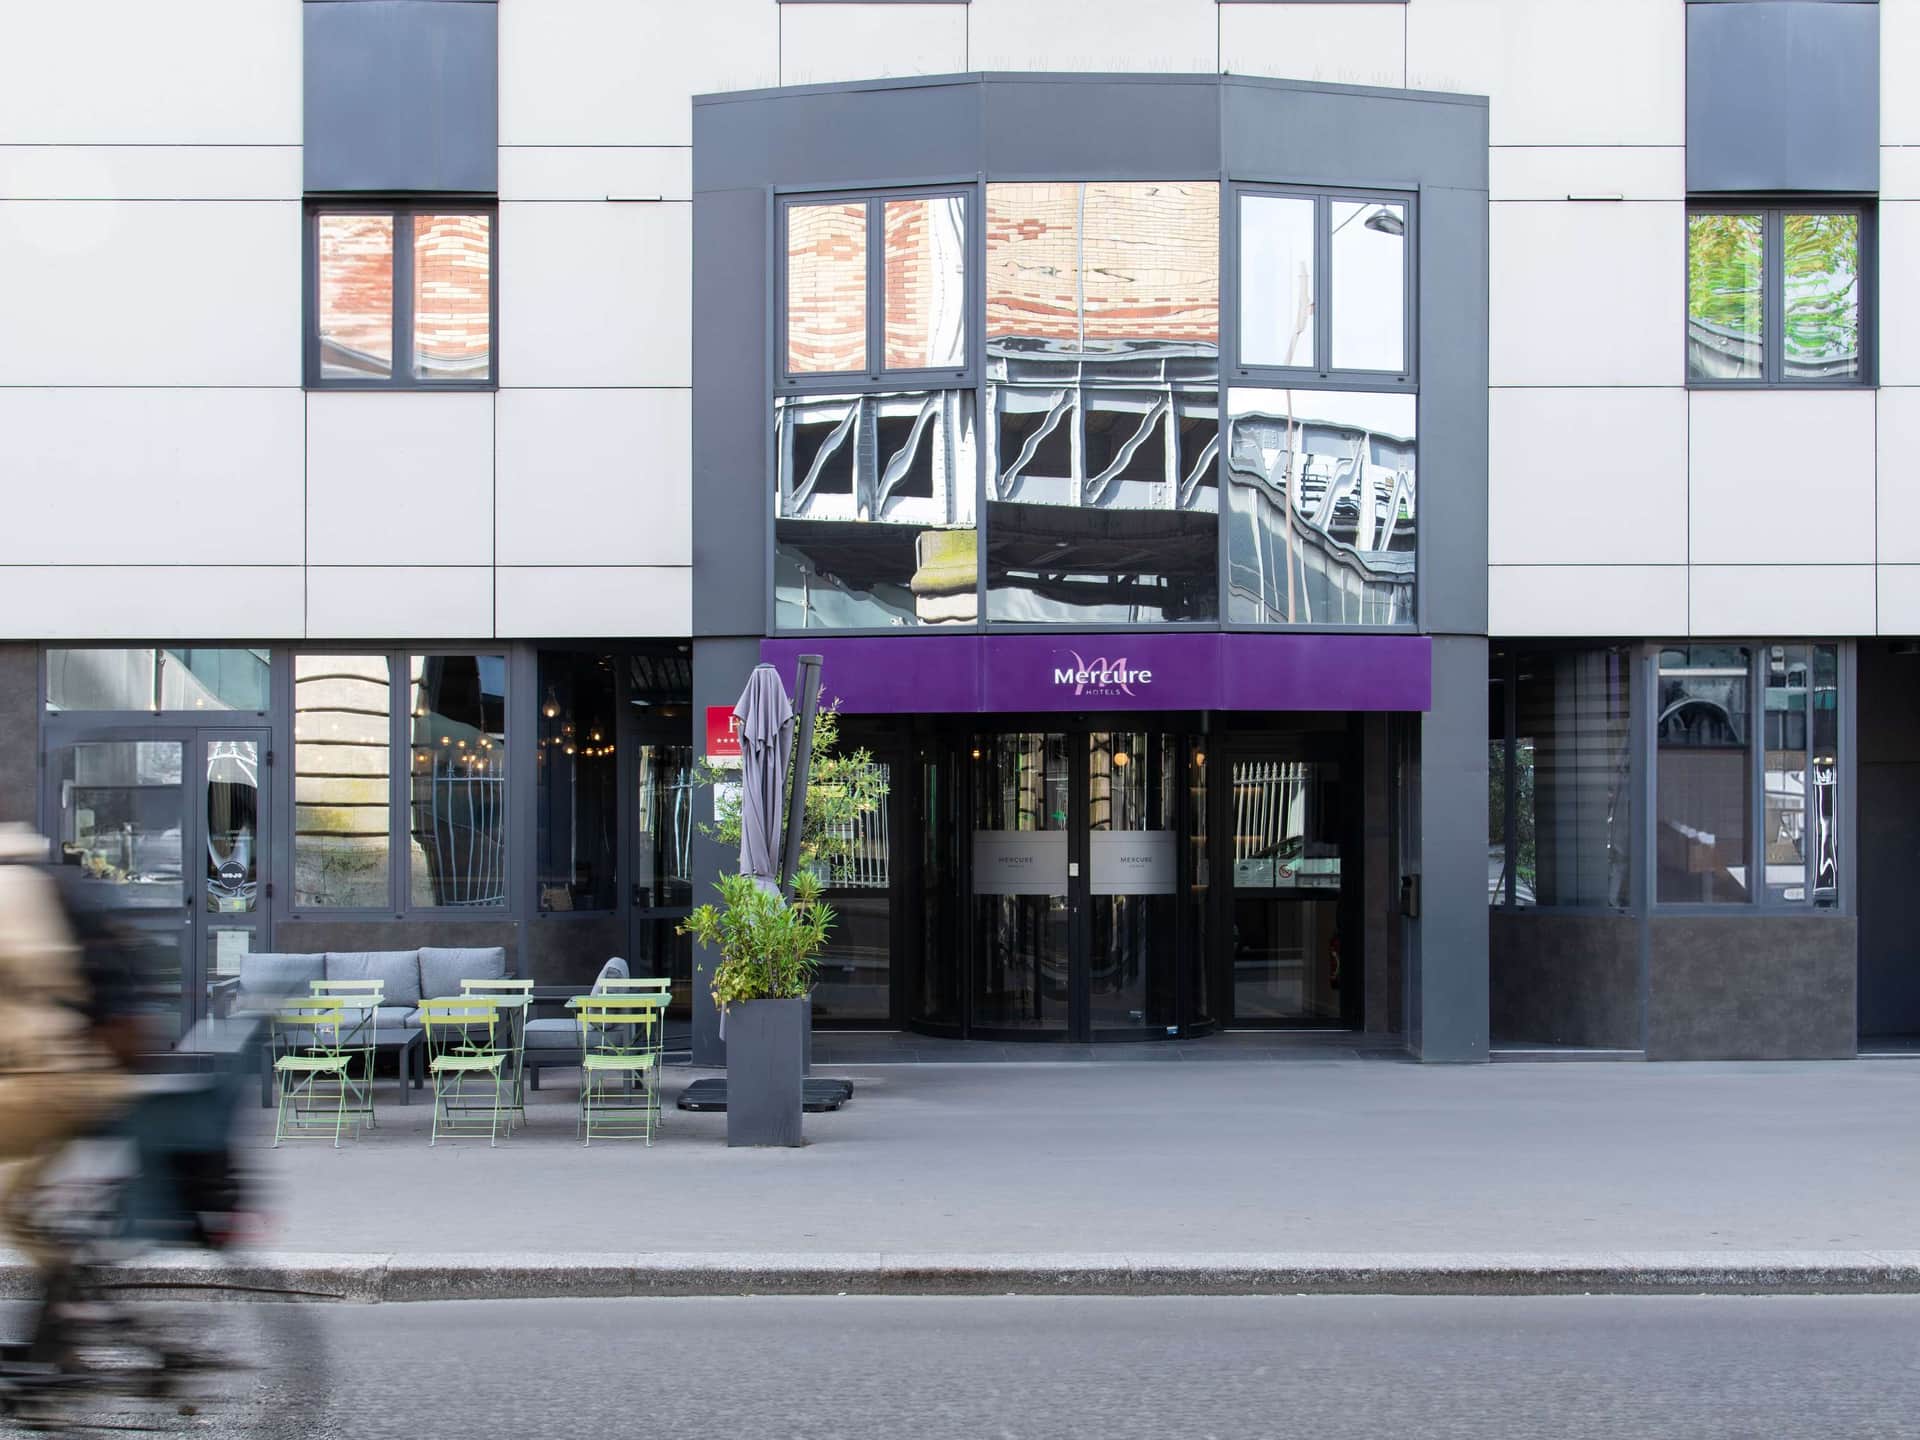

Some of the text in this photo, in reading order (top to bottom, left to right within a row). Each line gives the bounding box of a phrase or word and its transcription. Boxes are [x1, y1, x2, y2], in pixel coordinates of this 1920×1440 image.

[1055, 668, 1152, 684] Mercure
[998, 856, 1033, 864] MERCURE
[1120, 856, 1153, 864] MERCURE
